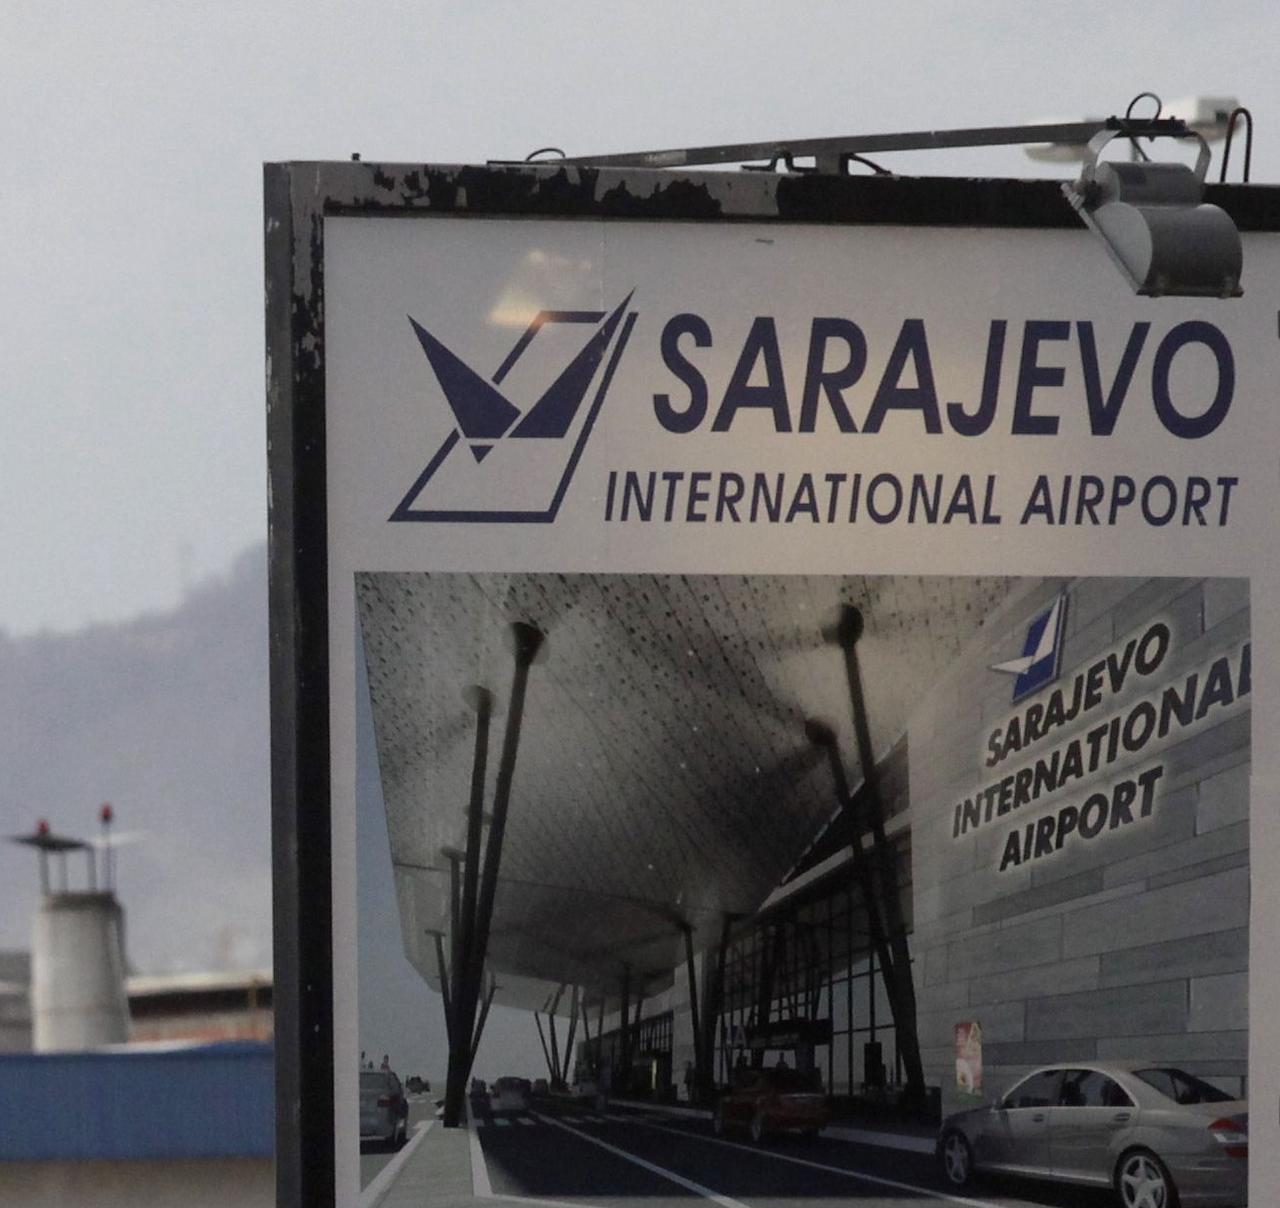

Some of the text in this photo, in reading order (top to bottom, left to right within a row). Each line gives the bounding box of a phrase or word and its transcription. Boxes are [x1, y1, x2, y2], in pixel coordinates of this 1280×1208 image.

[652, 312, 1237, 441] SARAJEVO
[604, 471, 1239, 529] INTERNATIONAL AIRPORT
[985, 623, 1171, 768] SARAJEVO
[999, 765, 1164, 872] AIRPORT
